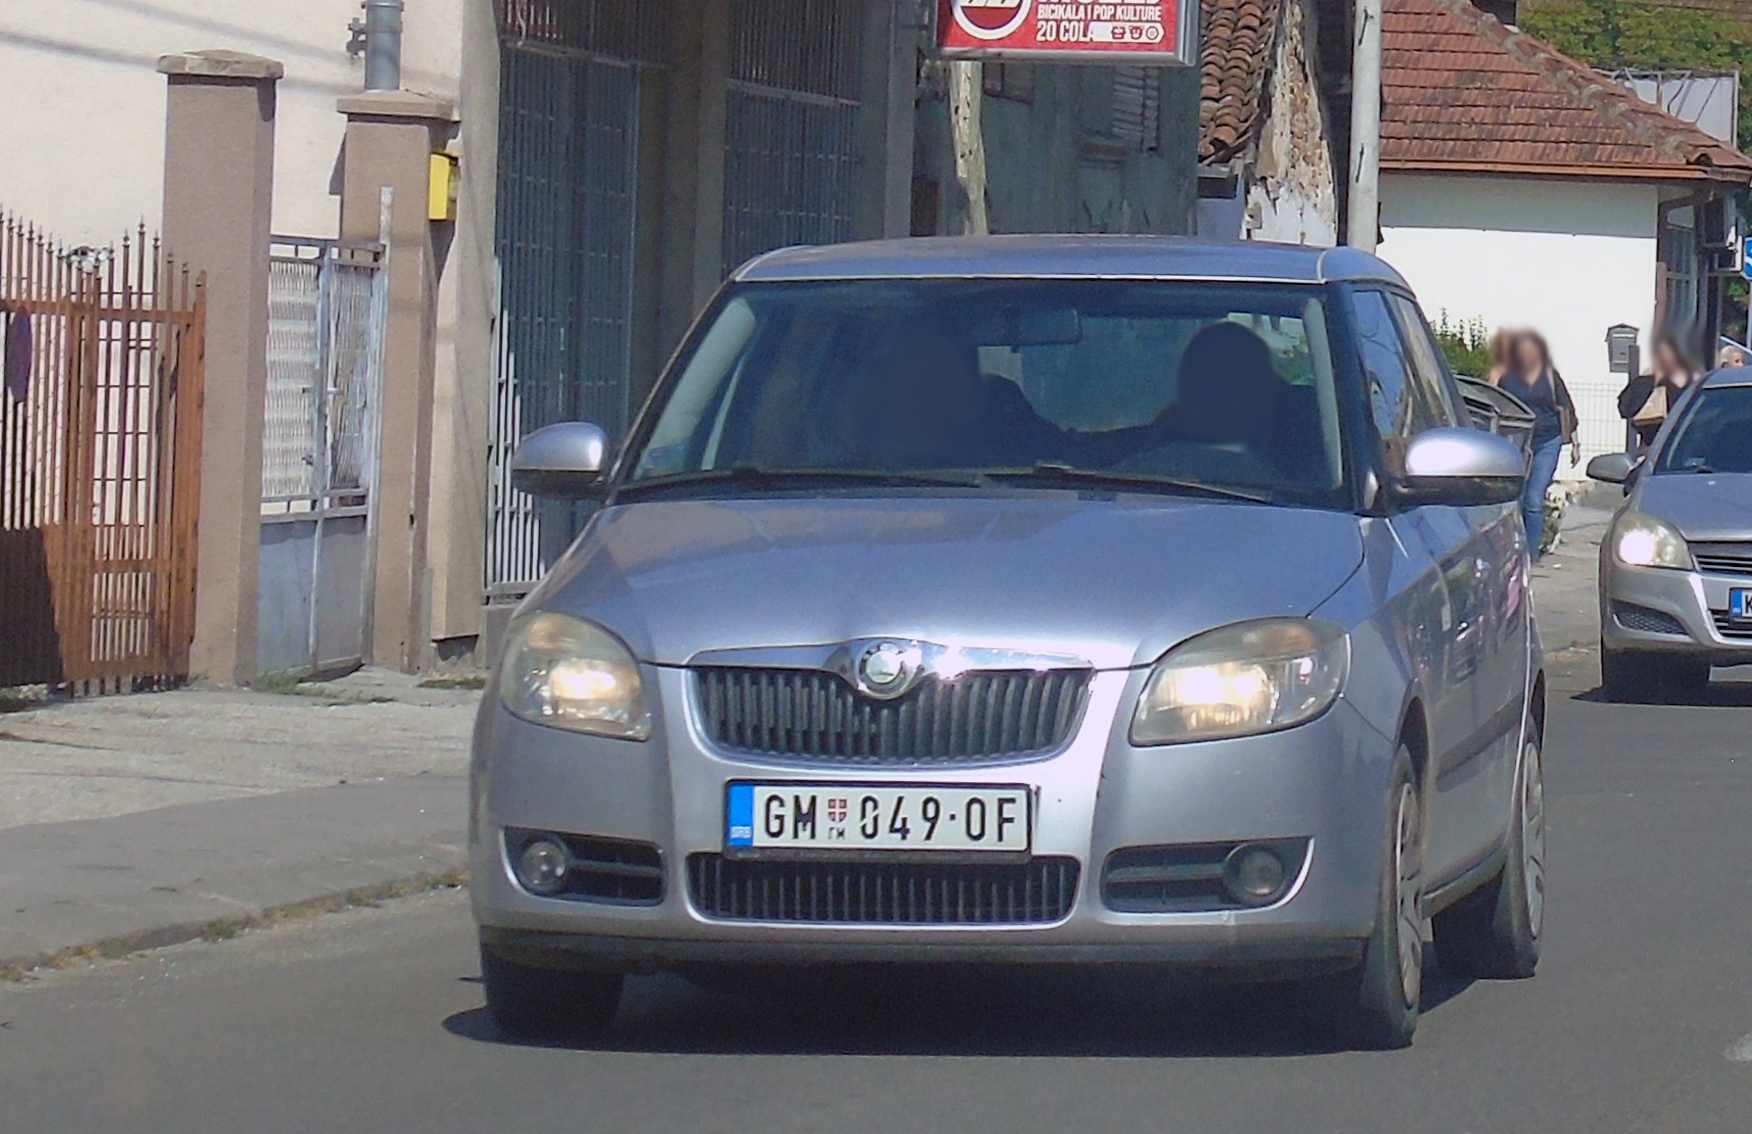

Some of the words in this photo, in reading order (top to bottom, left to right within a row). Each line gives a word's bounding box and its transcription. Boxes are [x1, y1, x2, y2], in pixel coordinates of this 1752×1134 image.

[1037, 4, 1085, 19] BICIKALA
[1087, 4, 1092, 20] I
[1093, 4, 1115, 20] POP
[1116, 5, 1162, 21] KULTURE
[1036, 20, 1057, 41] 20
[765, 794, 817, 839] GM
